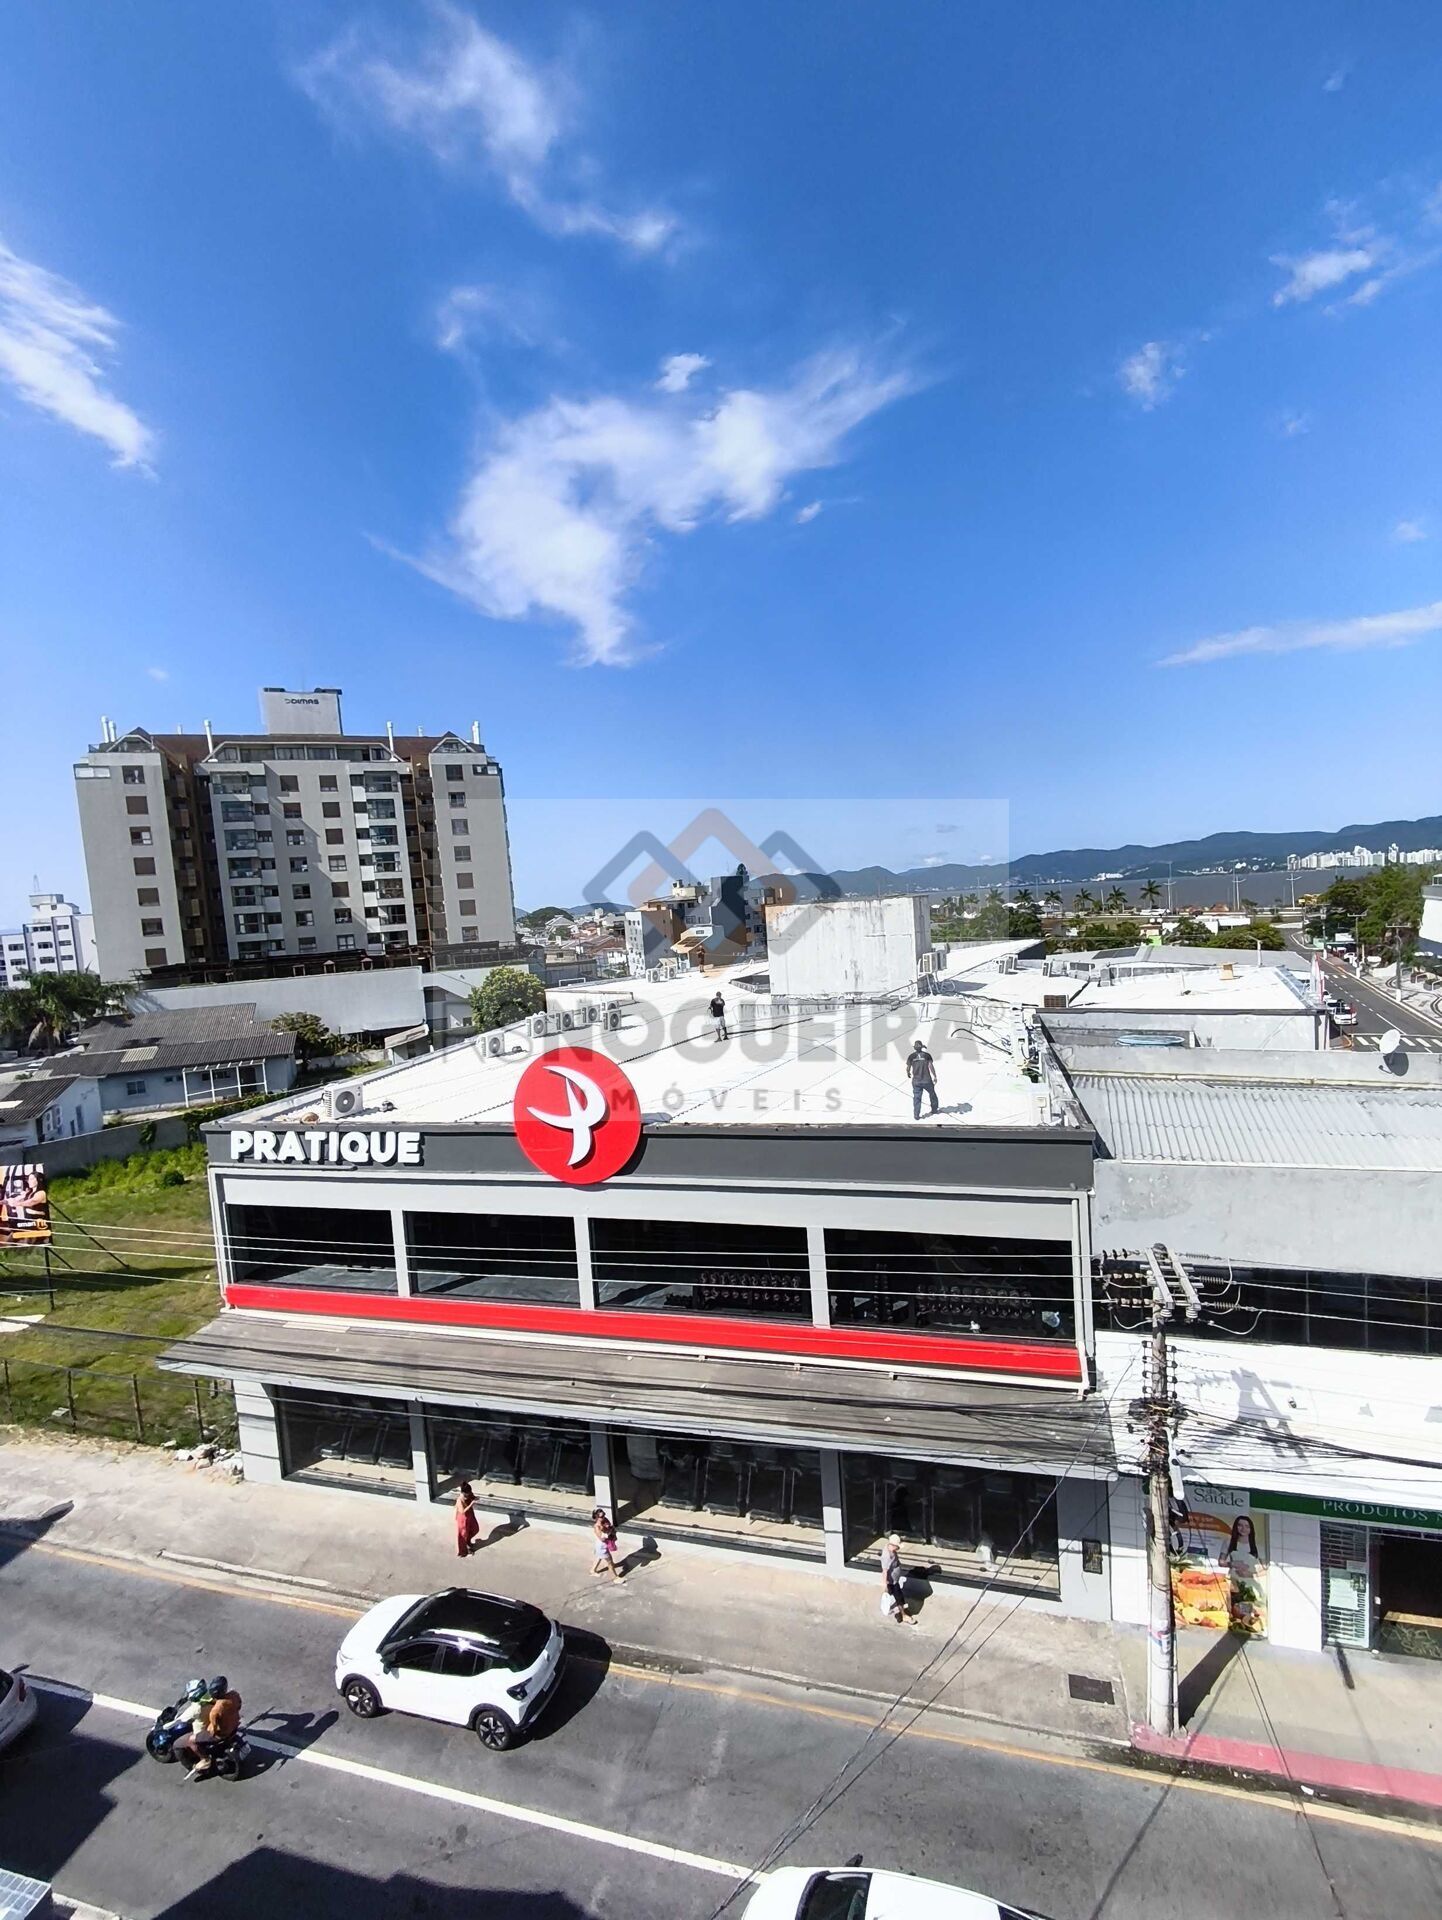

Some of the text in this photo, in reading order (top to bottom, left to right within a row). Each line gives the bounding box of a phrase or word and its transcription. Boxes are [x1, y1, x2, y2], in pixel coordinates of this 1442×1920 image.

[230, 1130, 421, 1164] PRATIQUE
[1193, 1487, 1244, 1507] Saúde
[1322, 1500, 1429, 1521] PRODUTOS
